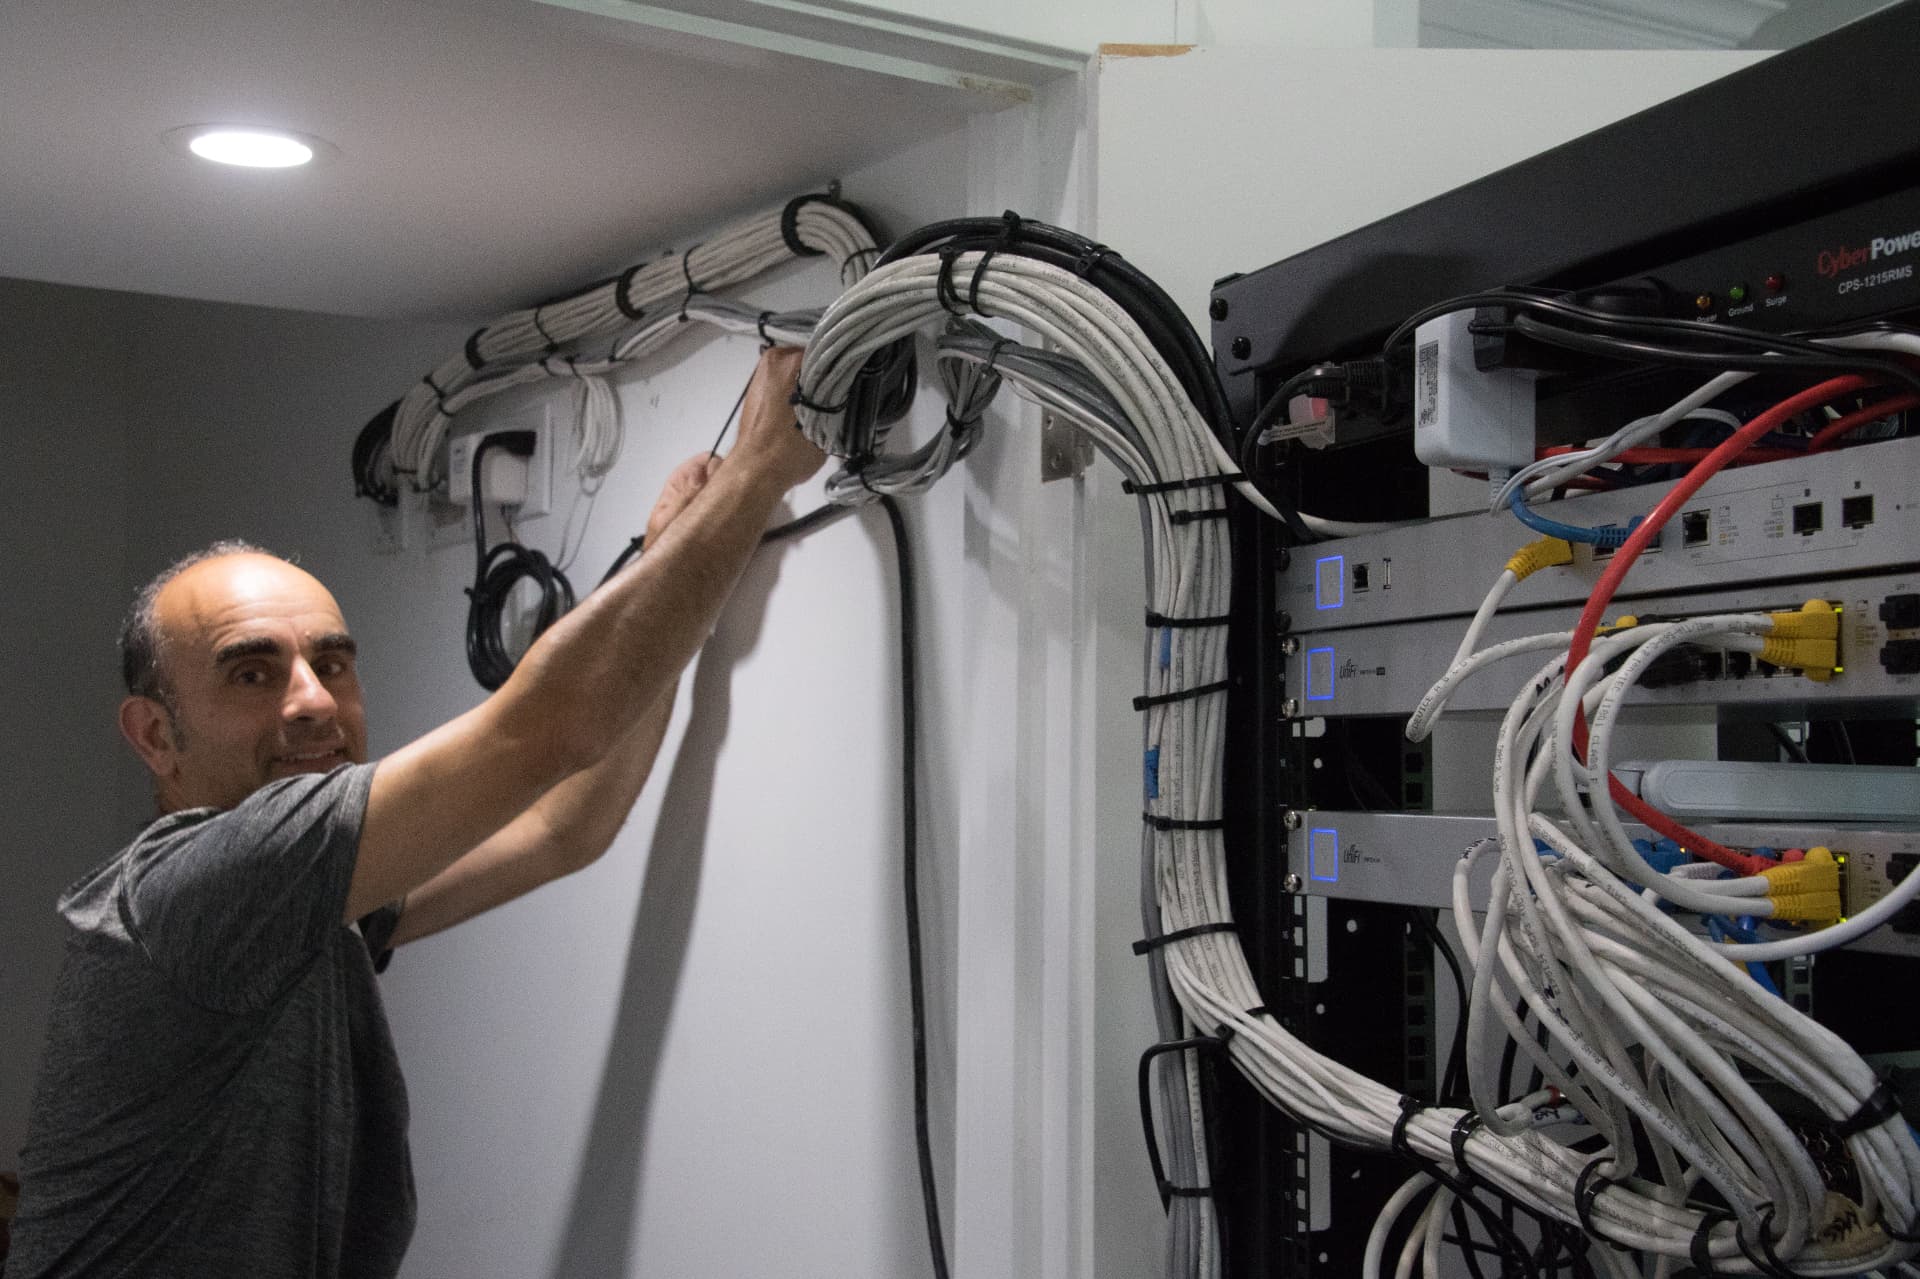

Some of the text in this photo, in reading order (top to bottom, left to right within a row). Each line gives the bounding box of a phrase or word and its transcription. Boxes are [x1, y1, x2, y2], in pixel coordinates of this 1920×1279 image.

[1838, 264, 1913, 295] CPS-1215RMS
[1765, 295, 1788, 307] Surge
[1728, 304, 1754, 317] Ground
